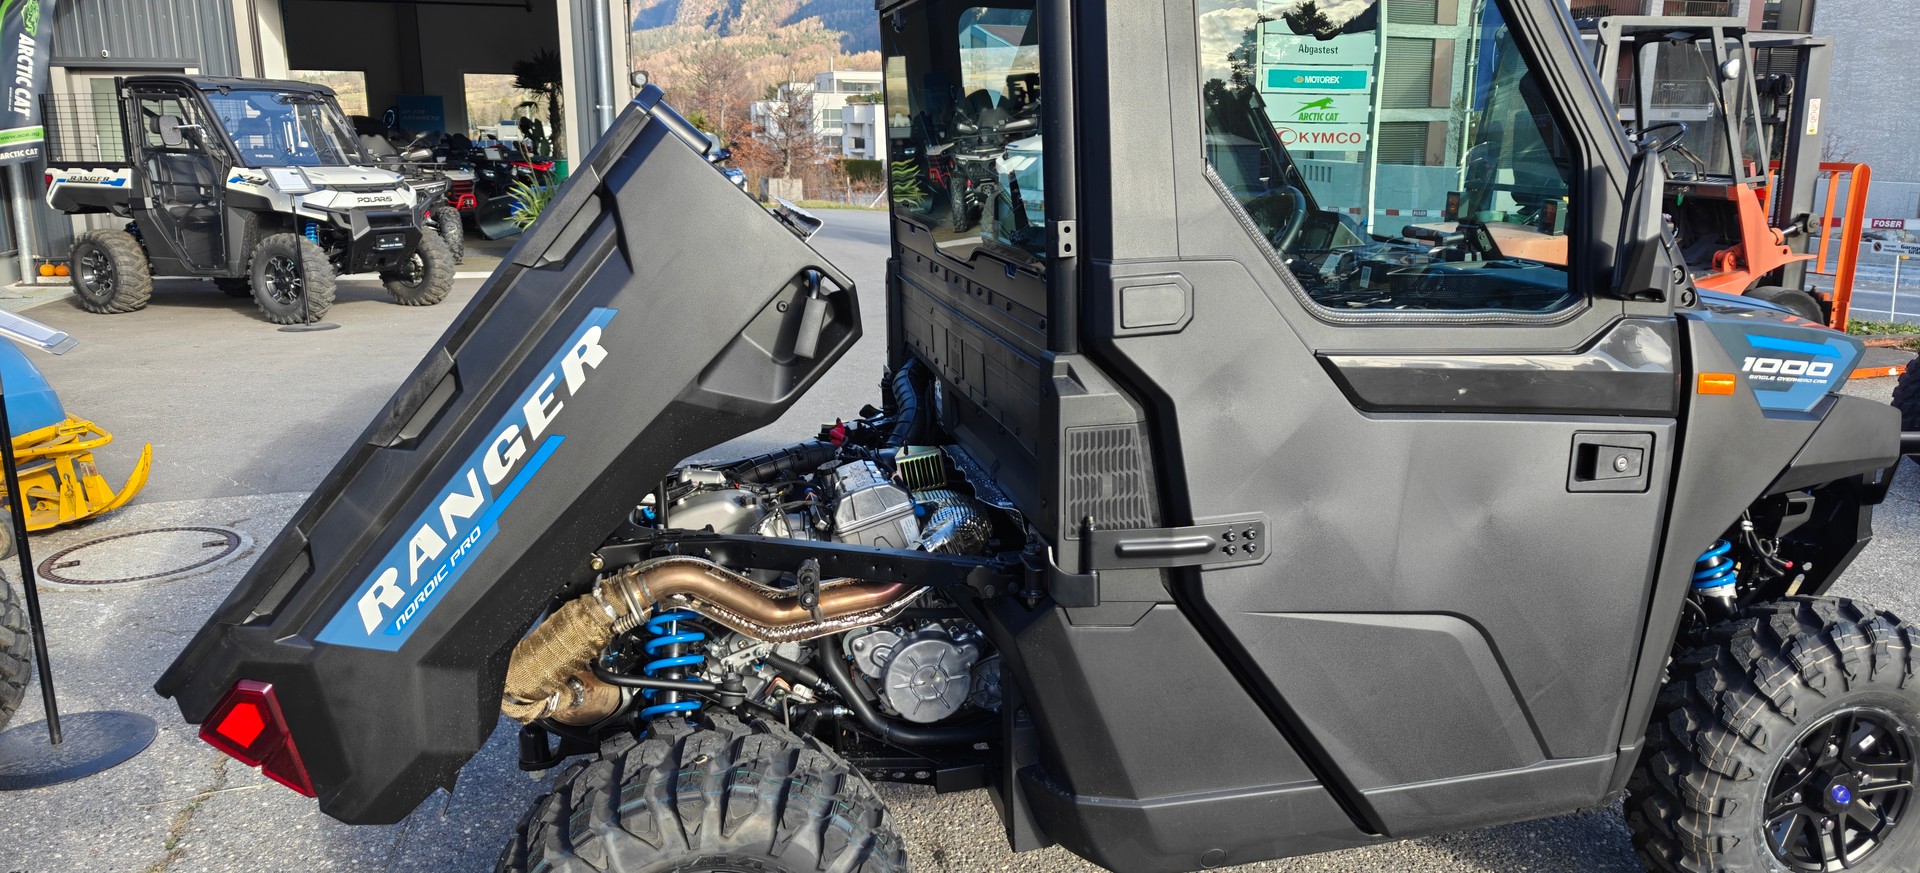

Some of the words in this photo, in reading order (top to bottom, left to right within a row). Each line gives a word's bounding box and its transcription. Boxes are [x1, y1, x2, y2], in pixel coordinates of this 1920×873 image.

[1298, 44, 1339, 55] Abgastest
[15, 33, 35, 87] ARCTIC
[1304, 75, 1340, 84] MOTOREX
[14, 87, 33, 117] CAT
[1298, 112, 1324, 121] ARCTIC
[1325, 112, 1340, 121] CAT
[1300, 132, 1361, 144] KYMCO
[0, 150, 25, 160] ARCTIC
[25, 148, 38, 156] CAT
[357, 196, 393, 204] POLARIS
[1873, 220, 1903, 228] FOSER
[1741, 356, 1834, 377] 1000
[357, 325, 609, 636] RANGER
[395, 564, 448, 630] NORDIC
[450, 525, 481, 567] PRO
